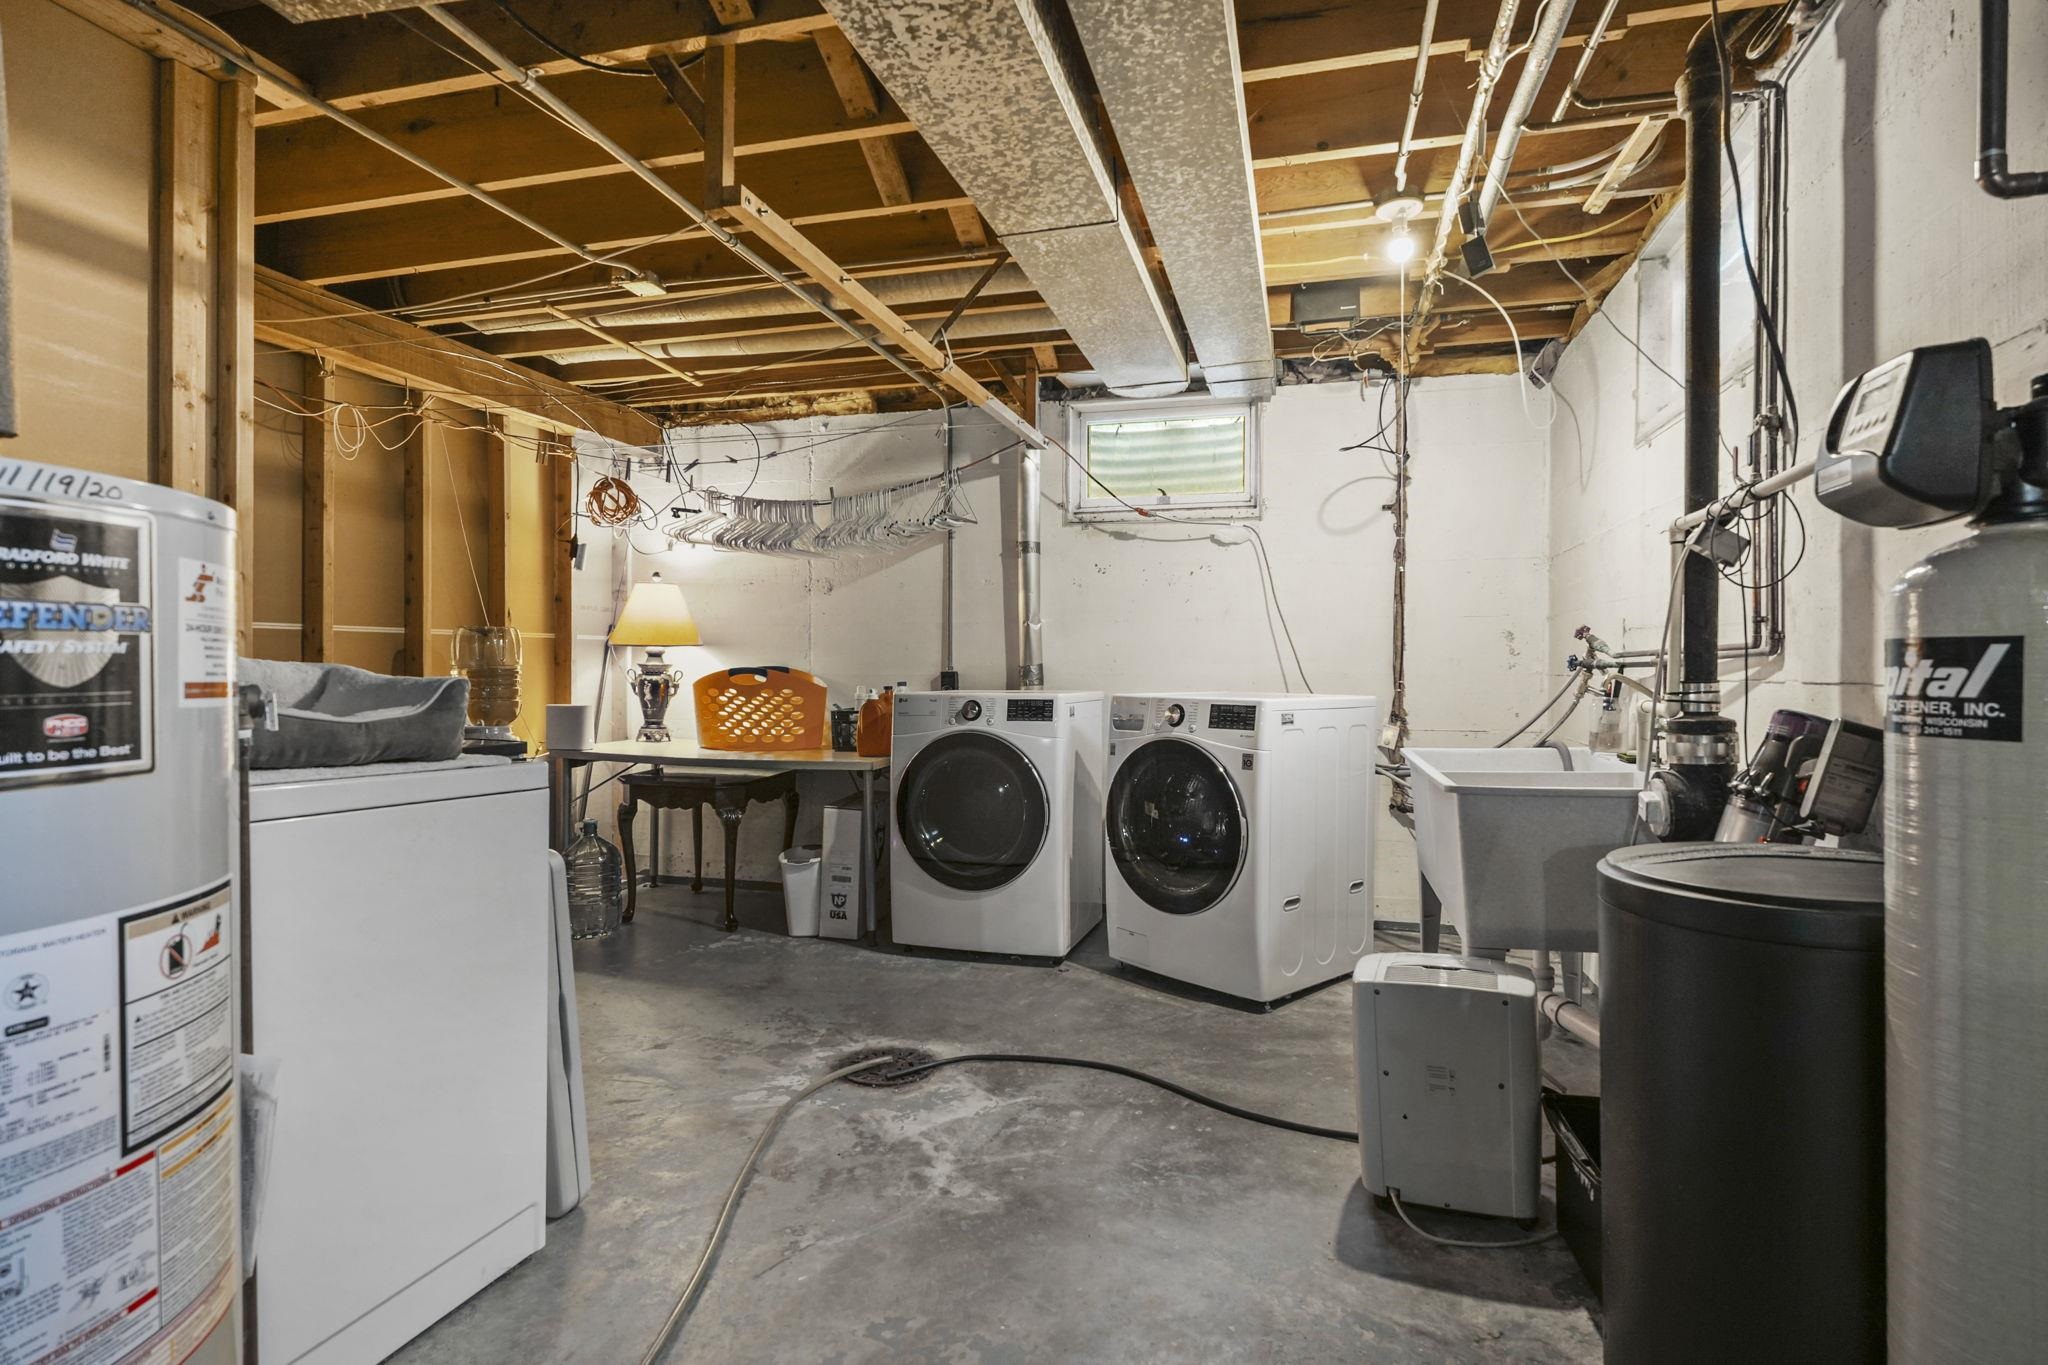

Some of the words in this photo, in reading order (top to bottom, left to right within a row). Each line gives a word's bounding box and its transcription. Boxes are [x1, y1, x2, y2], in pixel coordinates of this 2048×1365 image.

[81, 552, 131, 570] WHITE
[1963, 702, 2006, 717] INC.
[1925, 717, 1989, 728] WISCONSIN
[25, 751, 46, 763] to
[47, 749, 70, 761] be
[71, 747, 98, 759] the
[834, 895, 846, 906] NP
[829, 910, 848, 921] USA
